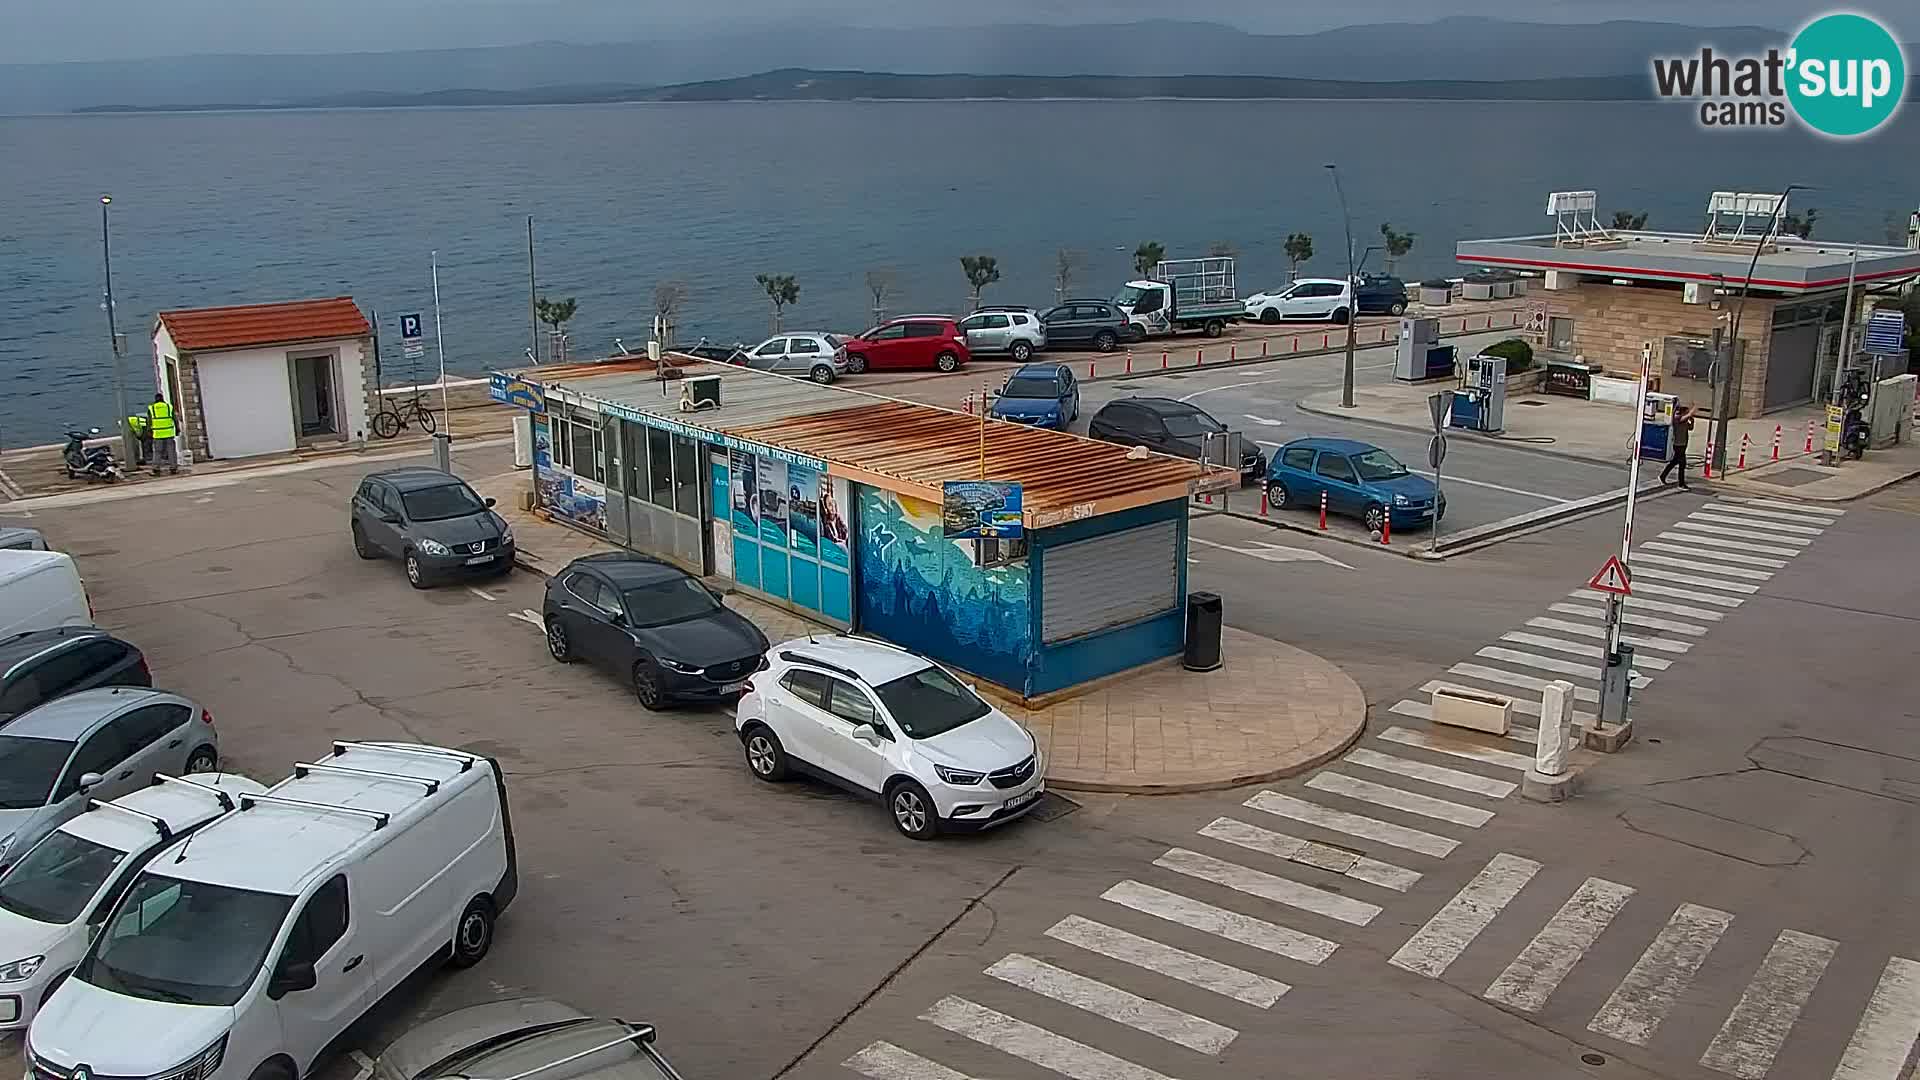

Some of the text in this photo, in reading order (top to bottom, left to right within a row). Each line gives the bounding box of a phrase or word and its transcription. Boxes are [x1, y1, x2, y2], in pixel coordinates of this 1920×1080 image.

[405, 317, 416, 335] P
[685, 426, 714, 443] POSTAJA
[724, 437, 823, 470] BUS STATION TICKET OFFICE
